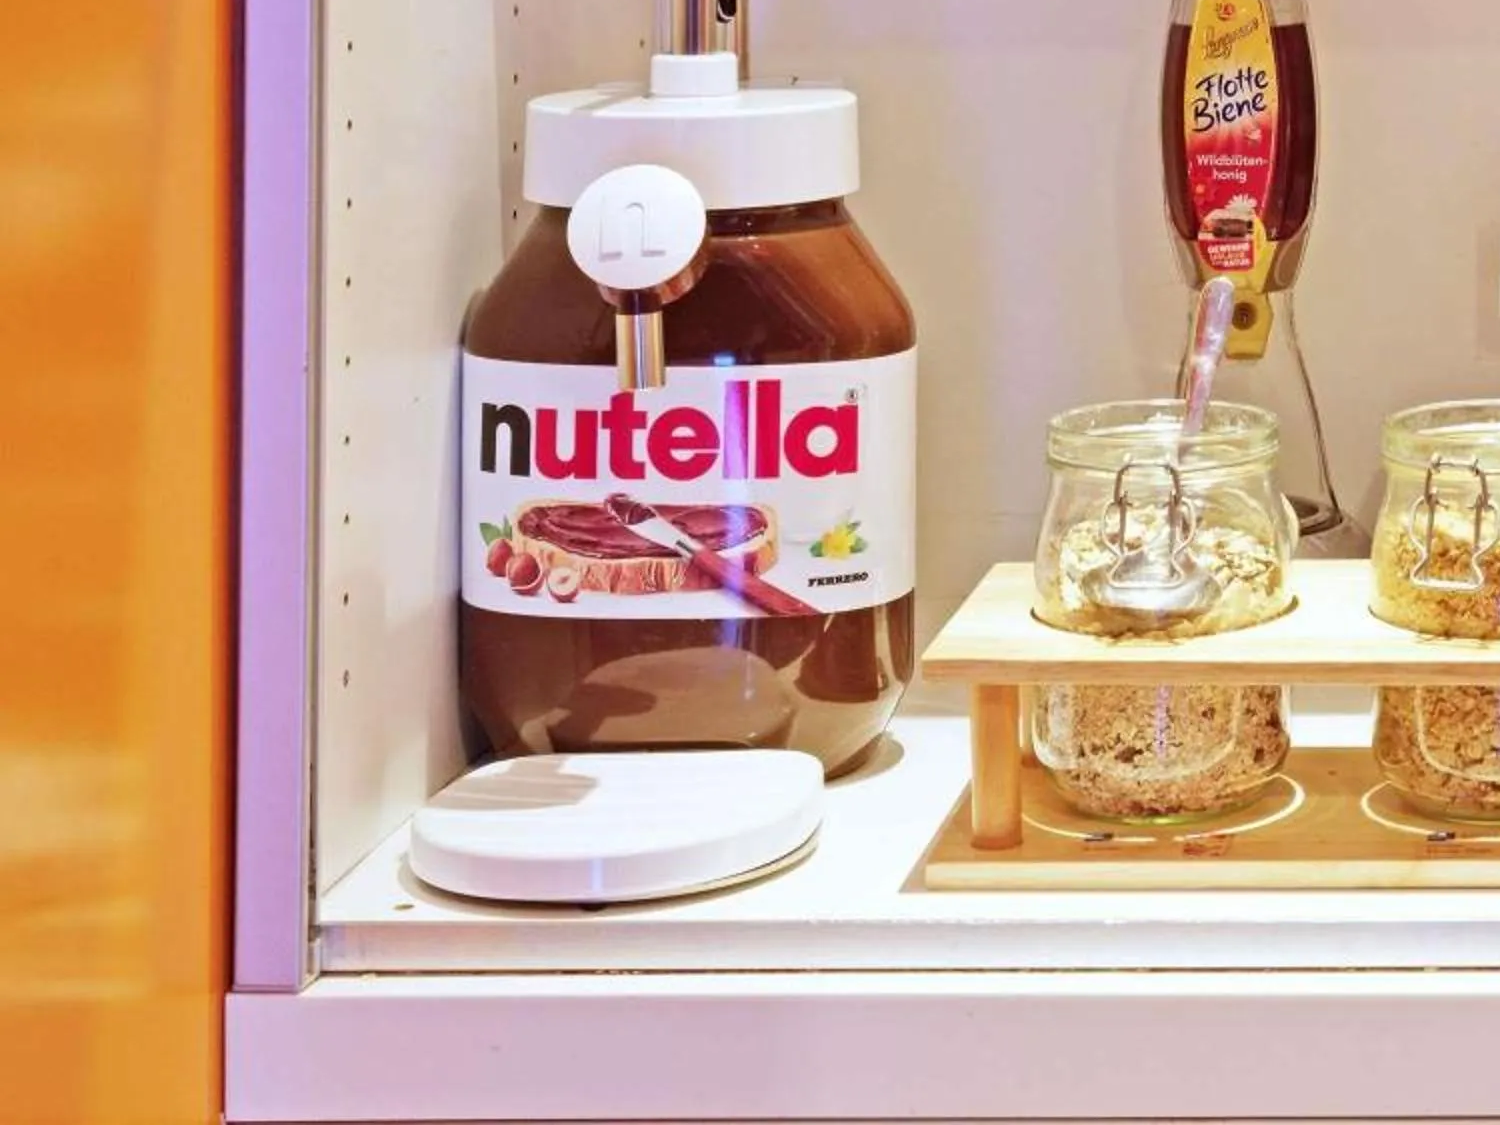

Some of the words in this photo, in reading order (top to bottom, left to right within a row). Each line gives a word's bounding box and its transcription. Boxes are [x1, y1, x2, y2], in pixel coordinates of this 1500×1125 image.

[1195, 67, 1269, 102] Flotte
[1192, 92, 1267, 132] Biene
[1196, 155, 1269, 166] Wildblüten-
[1213, 169, 1247, 184] honig
[480, 379, 860, 481] nutella
[808, 571, 869, 587] FERRERO
